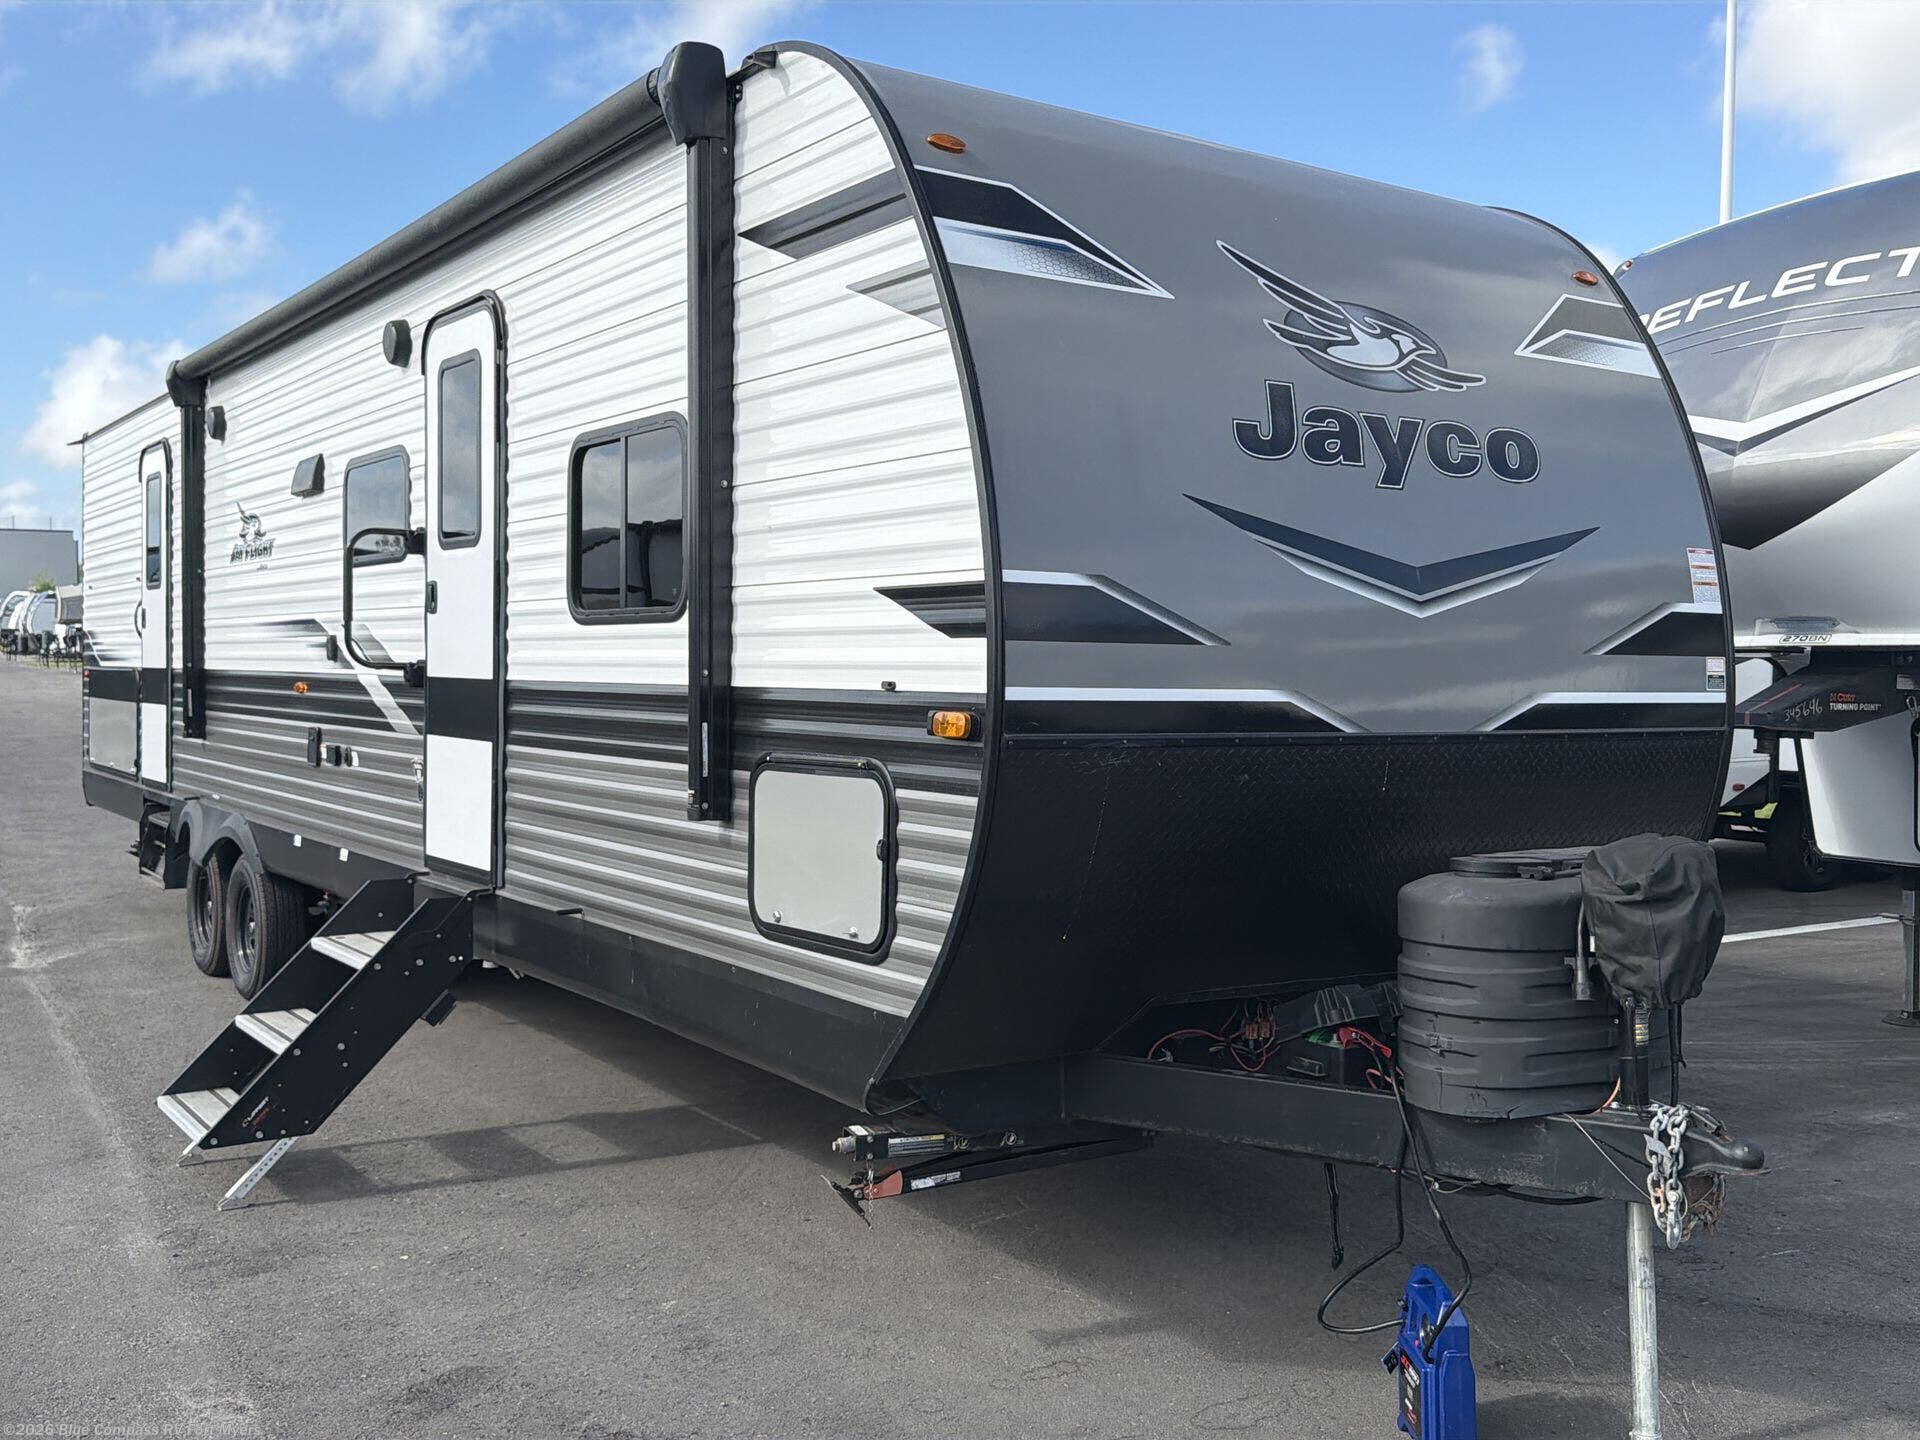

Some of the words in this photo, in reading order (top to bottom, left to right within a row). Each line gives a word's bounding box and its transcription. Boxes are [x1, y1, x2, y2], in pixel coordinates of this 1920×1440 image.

[1231, 379, 1541, 490] Jayco
[1782, 634, 1827, 642] 270BN
[1785, 698, 1823, 722] 345646
[1829, 702, 1858, 711] TURNING
